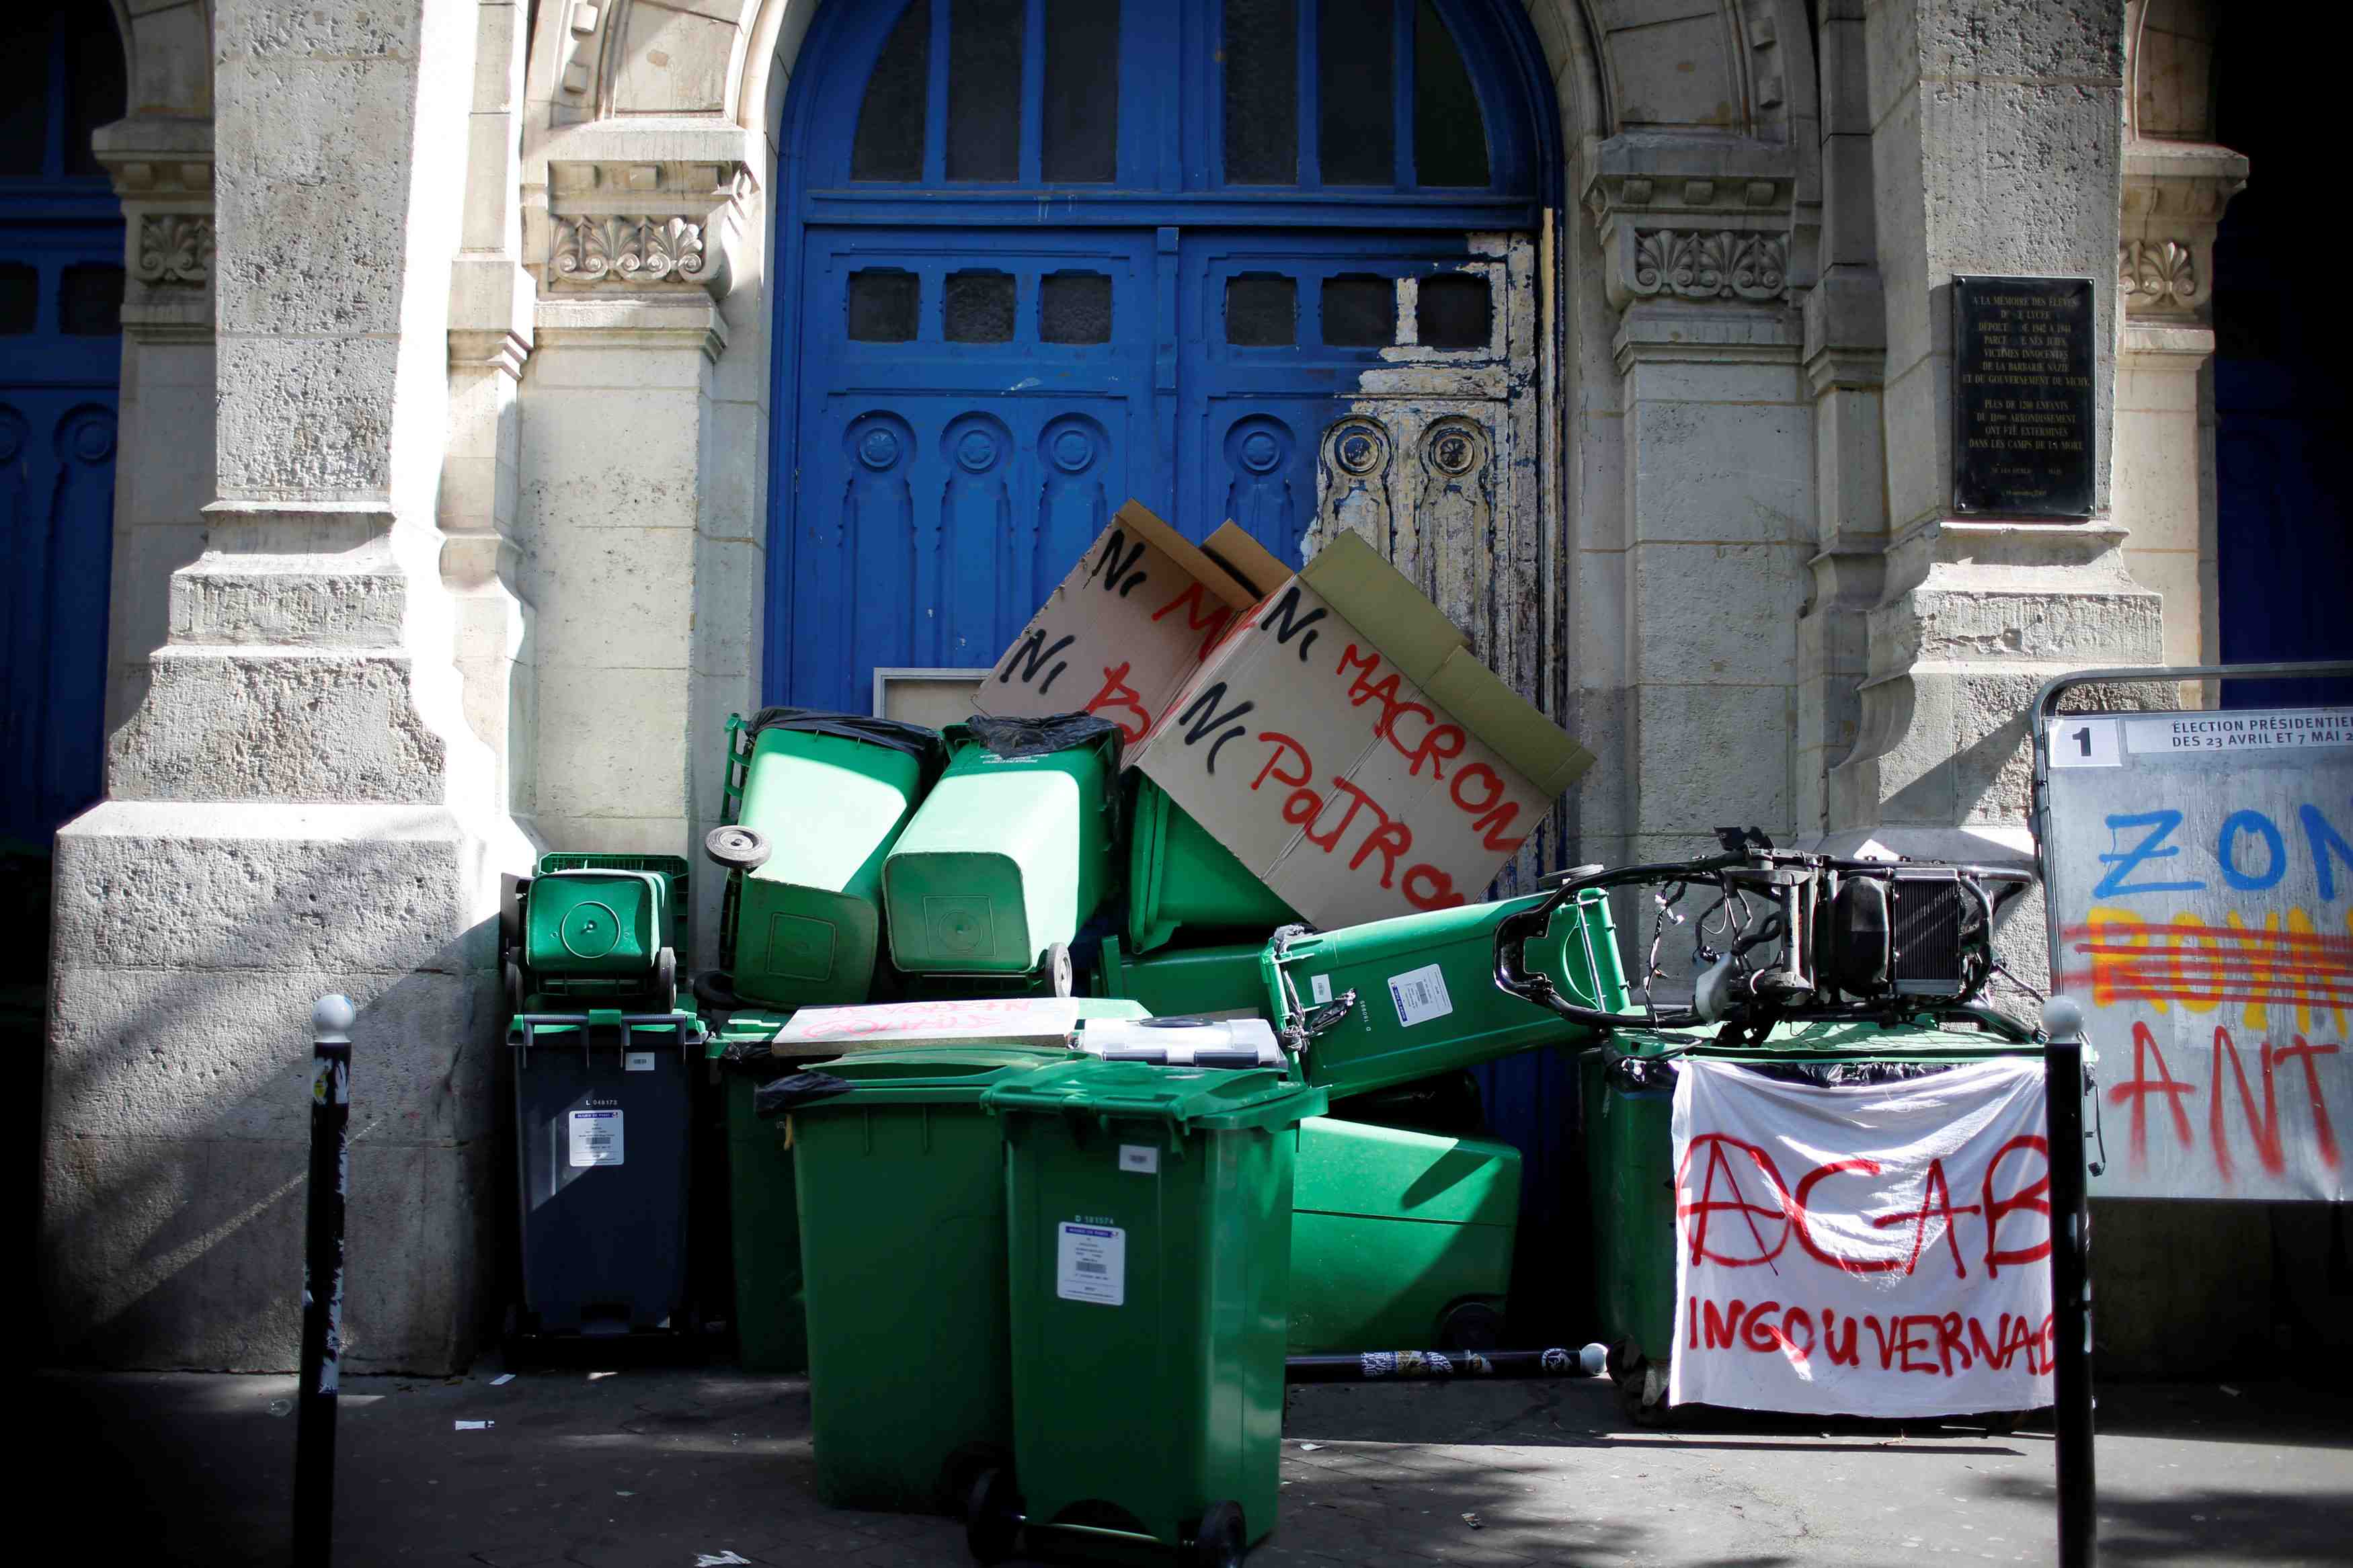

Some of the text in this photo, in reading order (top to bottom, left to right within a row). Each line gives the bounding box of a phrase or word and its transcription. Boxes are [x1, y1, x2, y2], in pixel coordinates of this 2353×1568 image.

[2172, 716, 2353, 733] ÉLECTION PRÉSIDENTIE
[2172, 736, 2200, 747] DES
[2206, 737, 2223, 748] 23
[2228, 733, 2271, 745] AVRIL
[2276, 732, 2292, 743] ET
[2297, 735, 2305, 745] 7
[2311, 731, 2340, 742] MAI
[1336, 643, 1526, 852] MACRON
[2072, 727, 2092, 757] 1
[1675, 1133, 2052, 1279] ACAB
